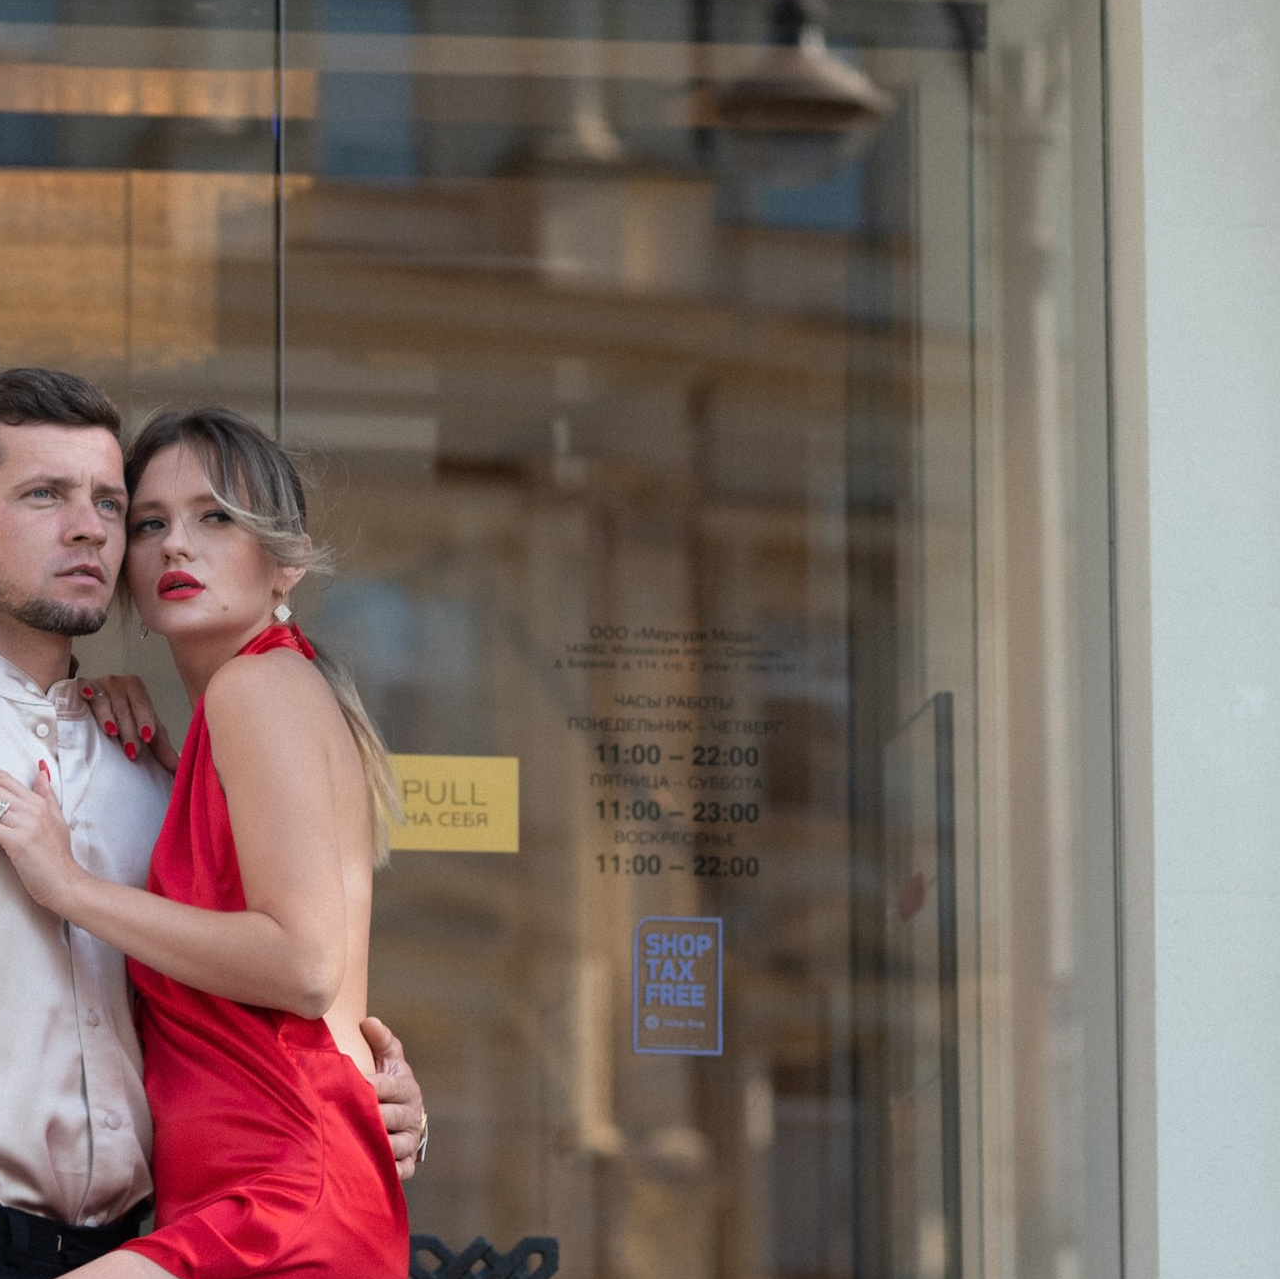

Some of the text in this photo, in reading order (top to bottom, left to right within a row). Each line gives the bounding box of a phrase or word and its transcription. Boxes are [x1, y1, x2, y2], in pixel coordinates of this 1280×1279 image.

[614, 694, 734, 710] ЧАСЫ РАБОТЫ
[566, 716, 692, 733] ПОНЕДЕЛЬНИК
[595, 744, 661, 765] 11:00
[692, 746, 759, 767] 22:00
[402, 779, 487, 806] PULL
[589, 773, 670, 790] ПЯТНИЦА
[687, 774, 763, 790] СУББОТА
[437, 811, 488, 827] СЕБЯ
[595, 799, 661, 820] 11:00
[692, 801, 759, 823] 23:00
[613, 830, 737, 847] ВОСКРЕСЕНЬЕ
[595, 854, 661, 874] 11:00
[692, 855, 760, 877] 22:00
[645, 933, 713, 957] SHOP
[645, 958, 695, 981] TAX
[645, 983, 706, 1007] FREE
